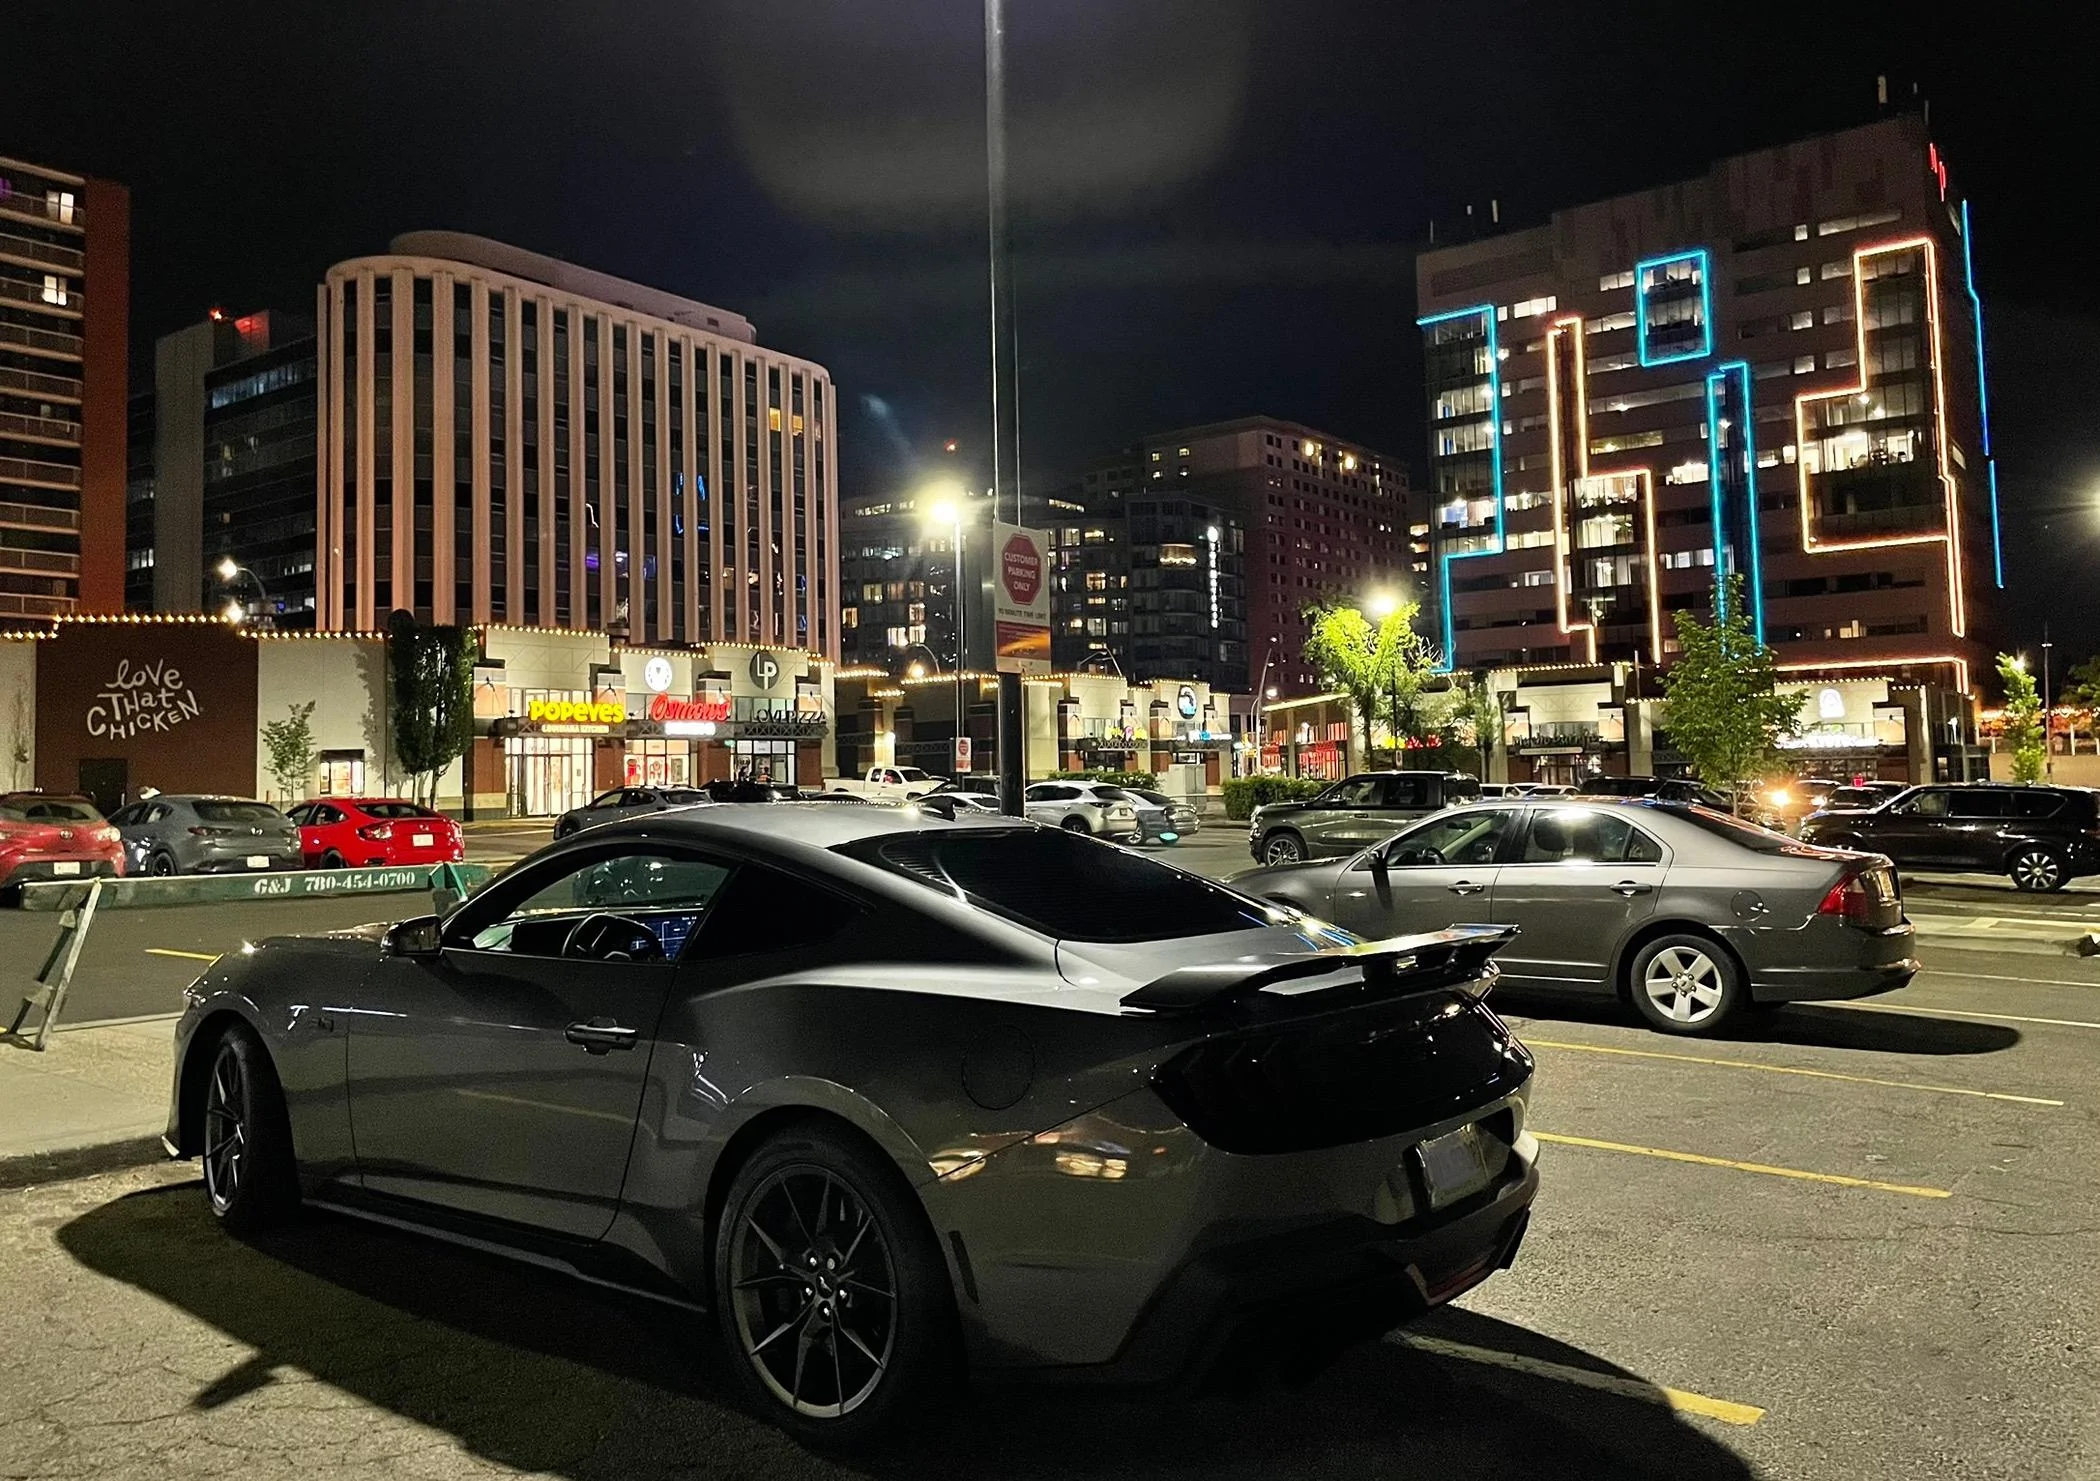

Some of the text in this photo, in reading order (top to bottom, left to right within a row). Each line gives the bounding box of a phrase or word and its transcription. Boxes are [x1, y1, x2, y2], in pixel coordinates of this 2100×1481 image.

[1004, 551, 1038, 566] CUSTOMER
[1007, 566, 1036, 579] PARKING
[1013, 581, 1031, 592] ONLY
[87, 689, 200, 740] CHICKEN
[750, 709, 827, 725] LOVE PIZZA
[254, 871, 415, 895] G&J 780-454-0700
